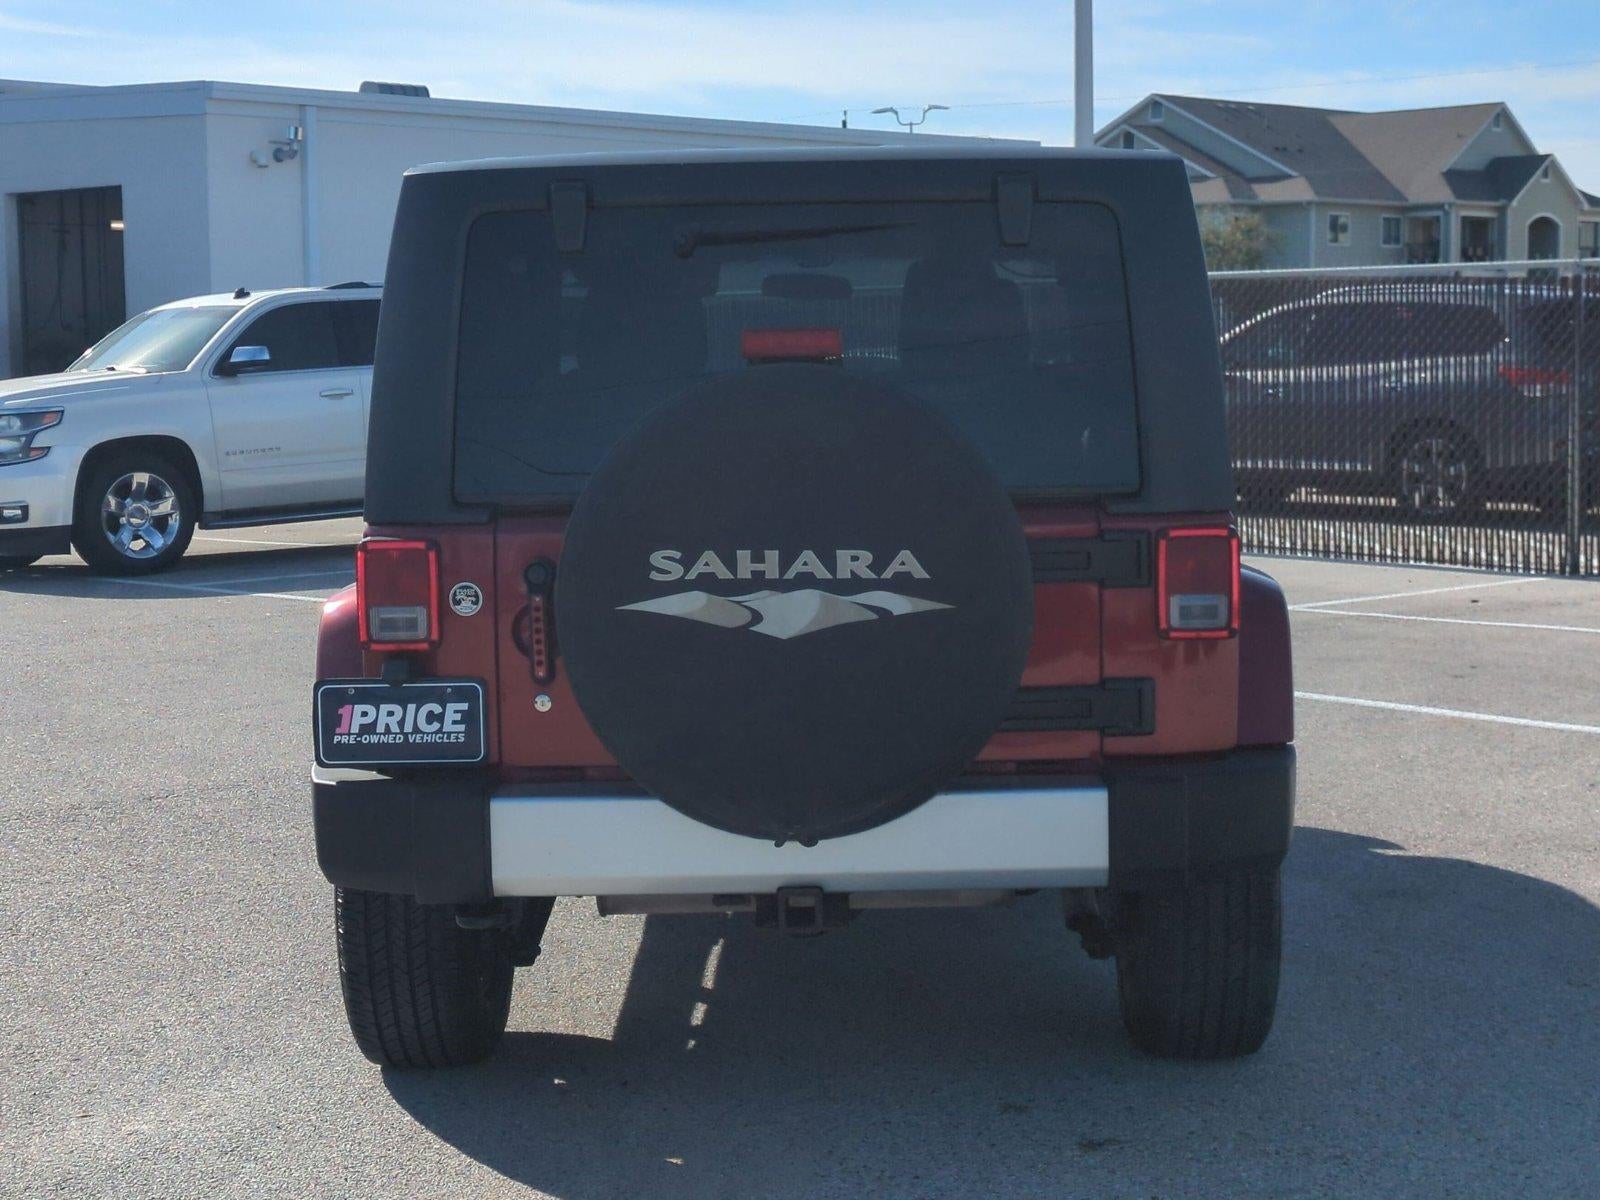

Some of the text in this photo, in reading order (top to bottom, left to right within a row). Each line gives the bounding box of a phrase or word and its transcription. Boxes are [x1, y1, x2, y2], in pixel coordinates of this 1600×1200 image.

[649, 549, 931, 581] SAHARA
[335, 702, 469, 734] 1PRICE
[333, 733, 466, 744] PRE-OWNED VEHICLES
